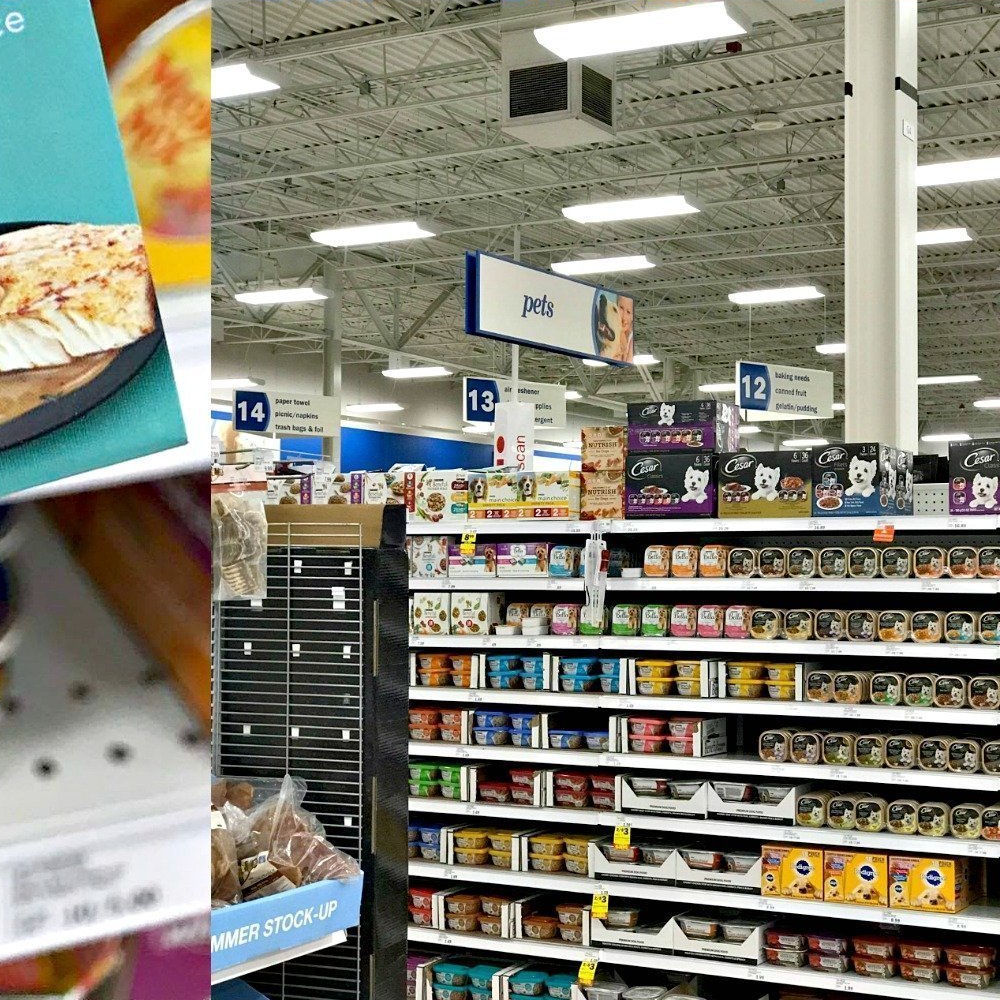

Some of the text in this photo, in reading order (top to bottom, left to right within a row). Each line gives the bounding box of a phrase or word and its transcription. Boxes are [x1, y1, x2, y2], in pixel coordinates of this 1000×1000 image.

[521, 294, 554, 318] pets
[775, 372, 793, 382] baking
[742, 374, 767, 400] 12
[775, 388, 807, 397] canned fruit
[468, 389, 495, 413] 13
[535, 403, 552, 411] pplies
[775, 402, 818, 414] gelatin/pudding
[238, 401, 265, 422] 14
[275, 412, 318, 420] picnic/napkins
[724, 454, 752, 473] Cesar
[818, 448, 846, 466] Cesar
[966, 449, 995, 467] Cesar
[631, 458, 658, 477] Cesar
[587, 489, 617, 497] NUTRISH
[211, 900, 338, 952] MMER STOCK-UP
